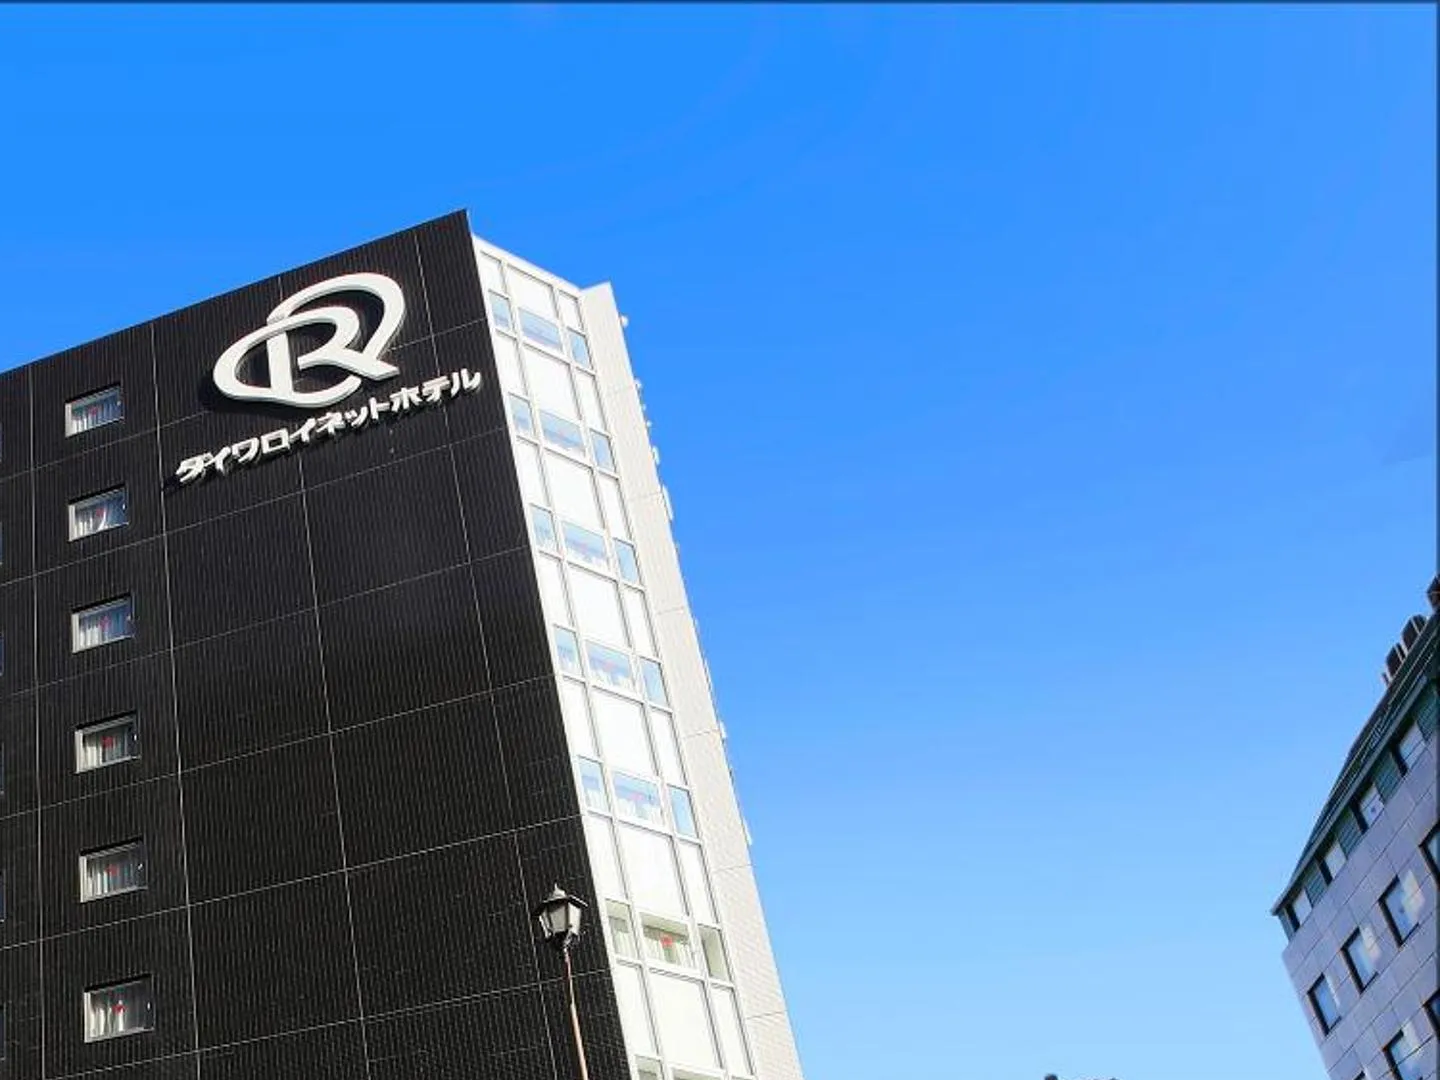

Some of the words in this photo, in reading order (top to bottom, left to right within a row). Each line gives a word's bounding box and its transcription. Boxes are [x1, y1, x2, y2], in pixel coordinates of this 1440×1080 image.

[175, 367, 482, 483] ダイワロイネットホテル
